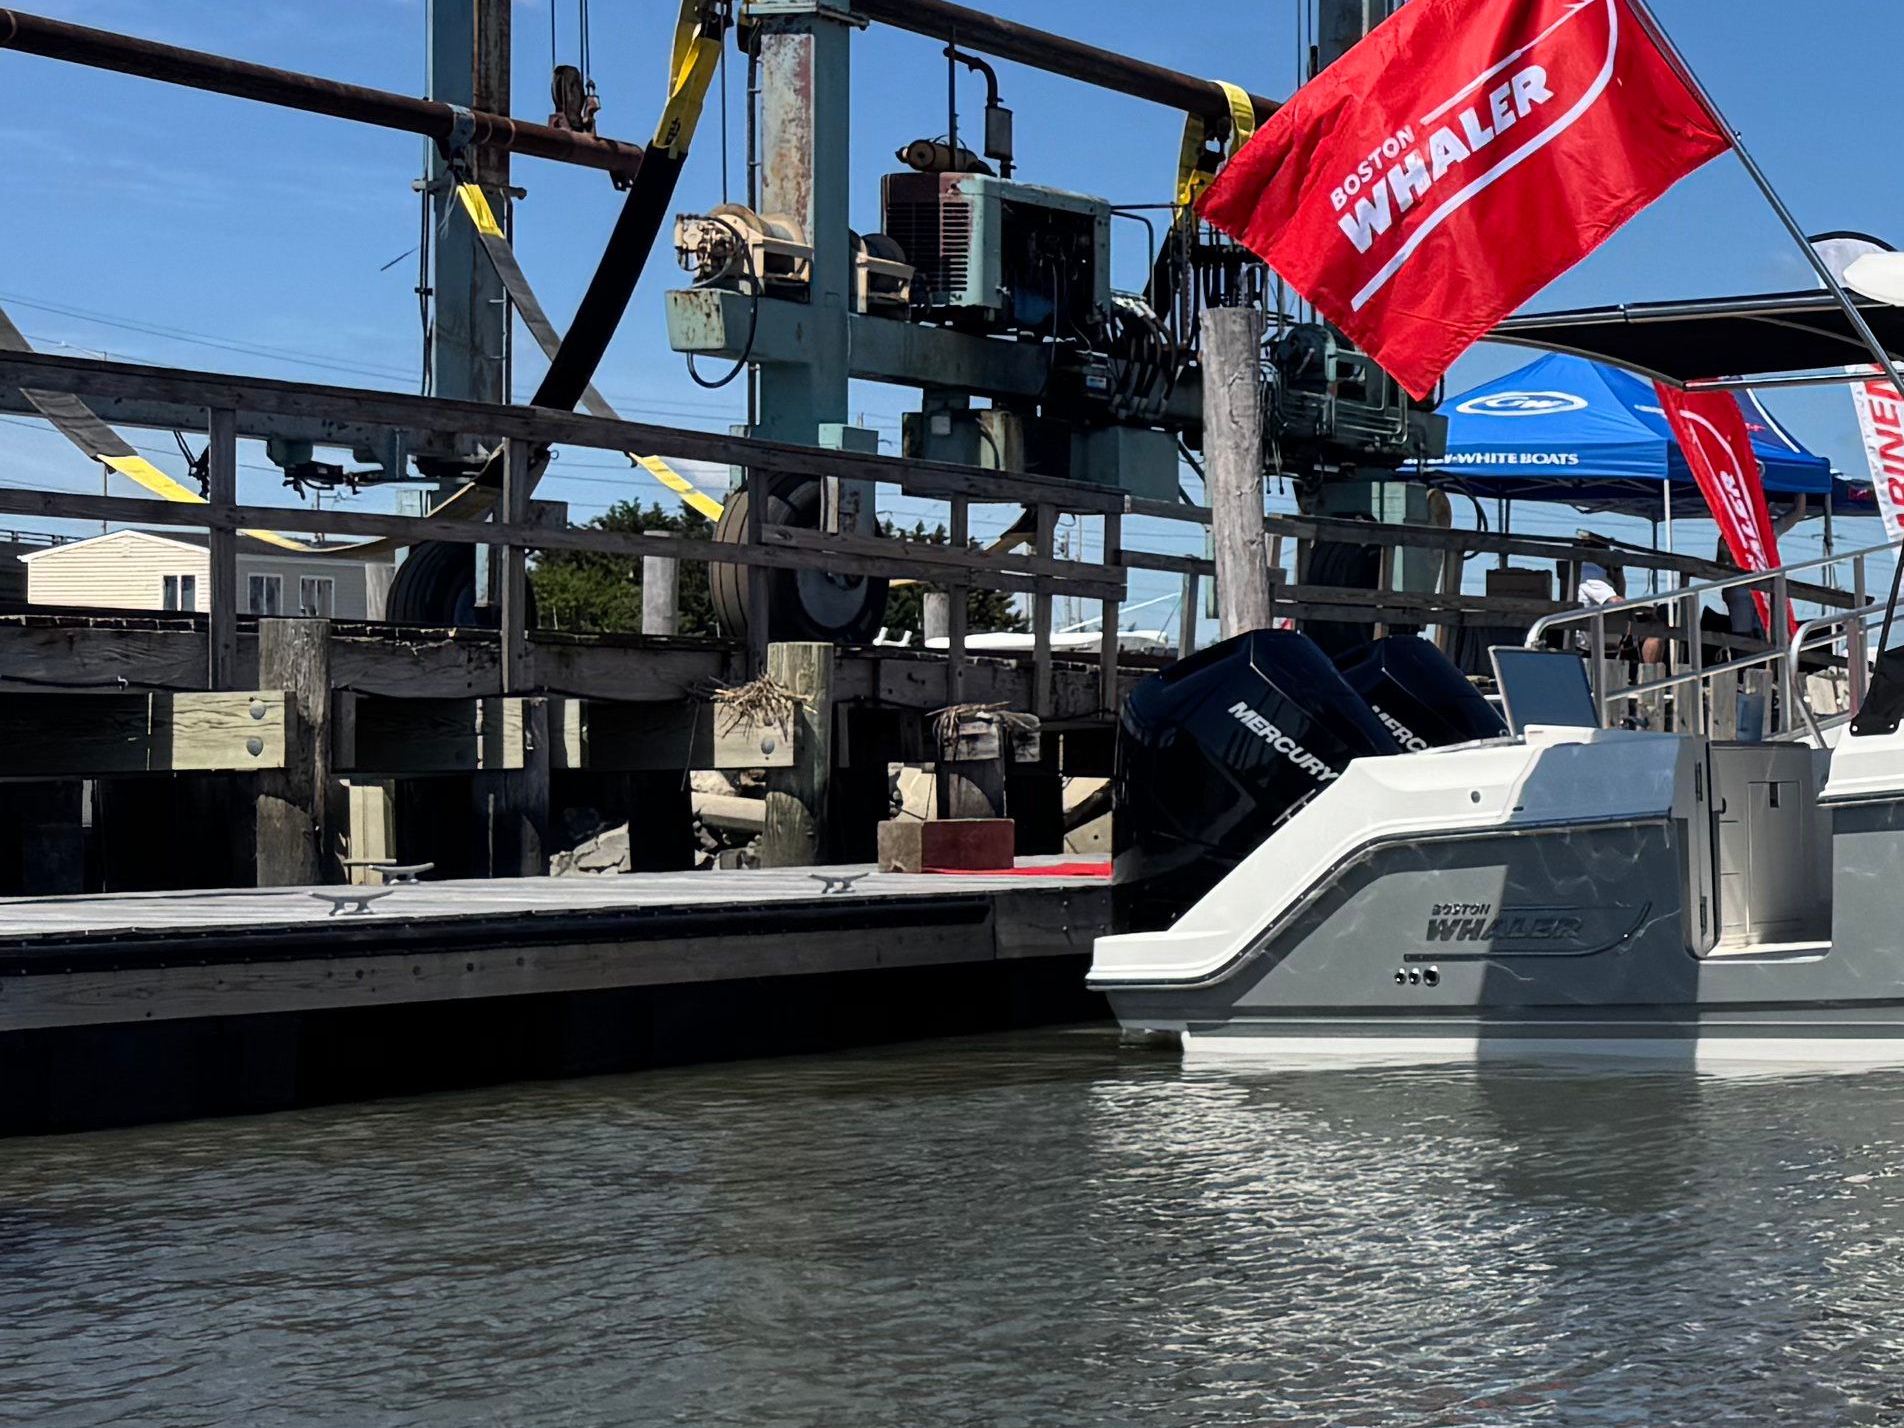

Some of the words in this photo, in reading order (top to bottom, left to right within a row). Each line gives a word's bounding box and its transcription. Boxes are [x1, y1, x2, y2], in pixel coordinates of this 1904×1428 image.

[1329, 124, 1416, 212] BOSTON
[1338, 65, 1554, 254] WHALER
[1519, 453, 1580, 465] BOATS
[1227, 701, 1340, 781] MERCURY
[1426, 917, 1583, 941] WHALER
[1432, 903, 1491, 916] BOSTON
